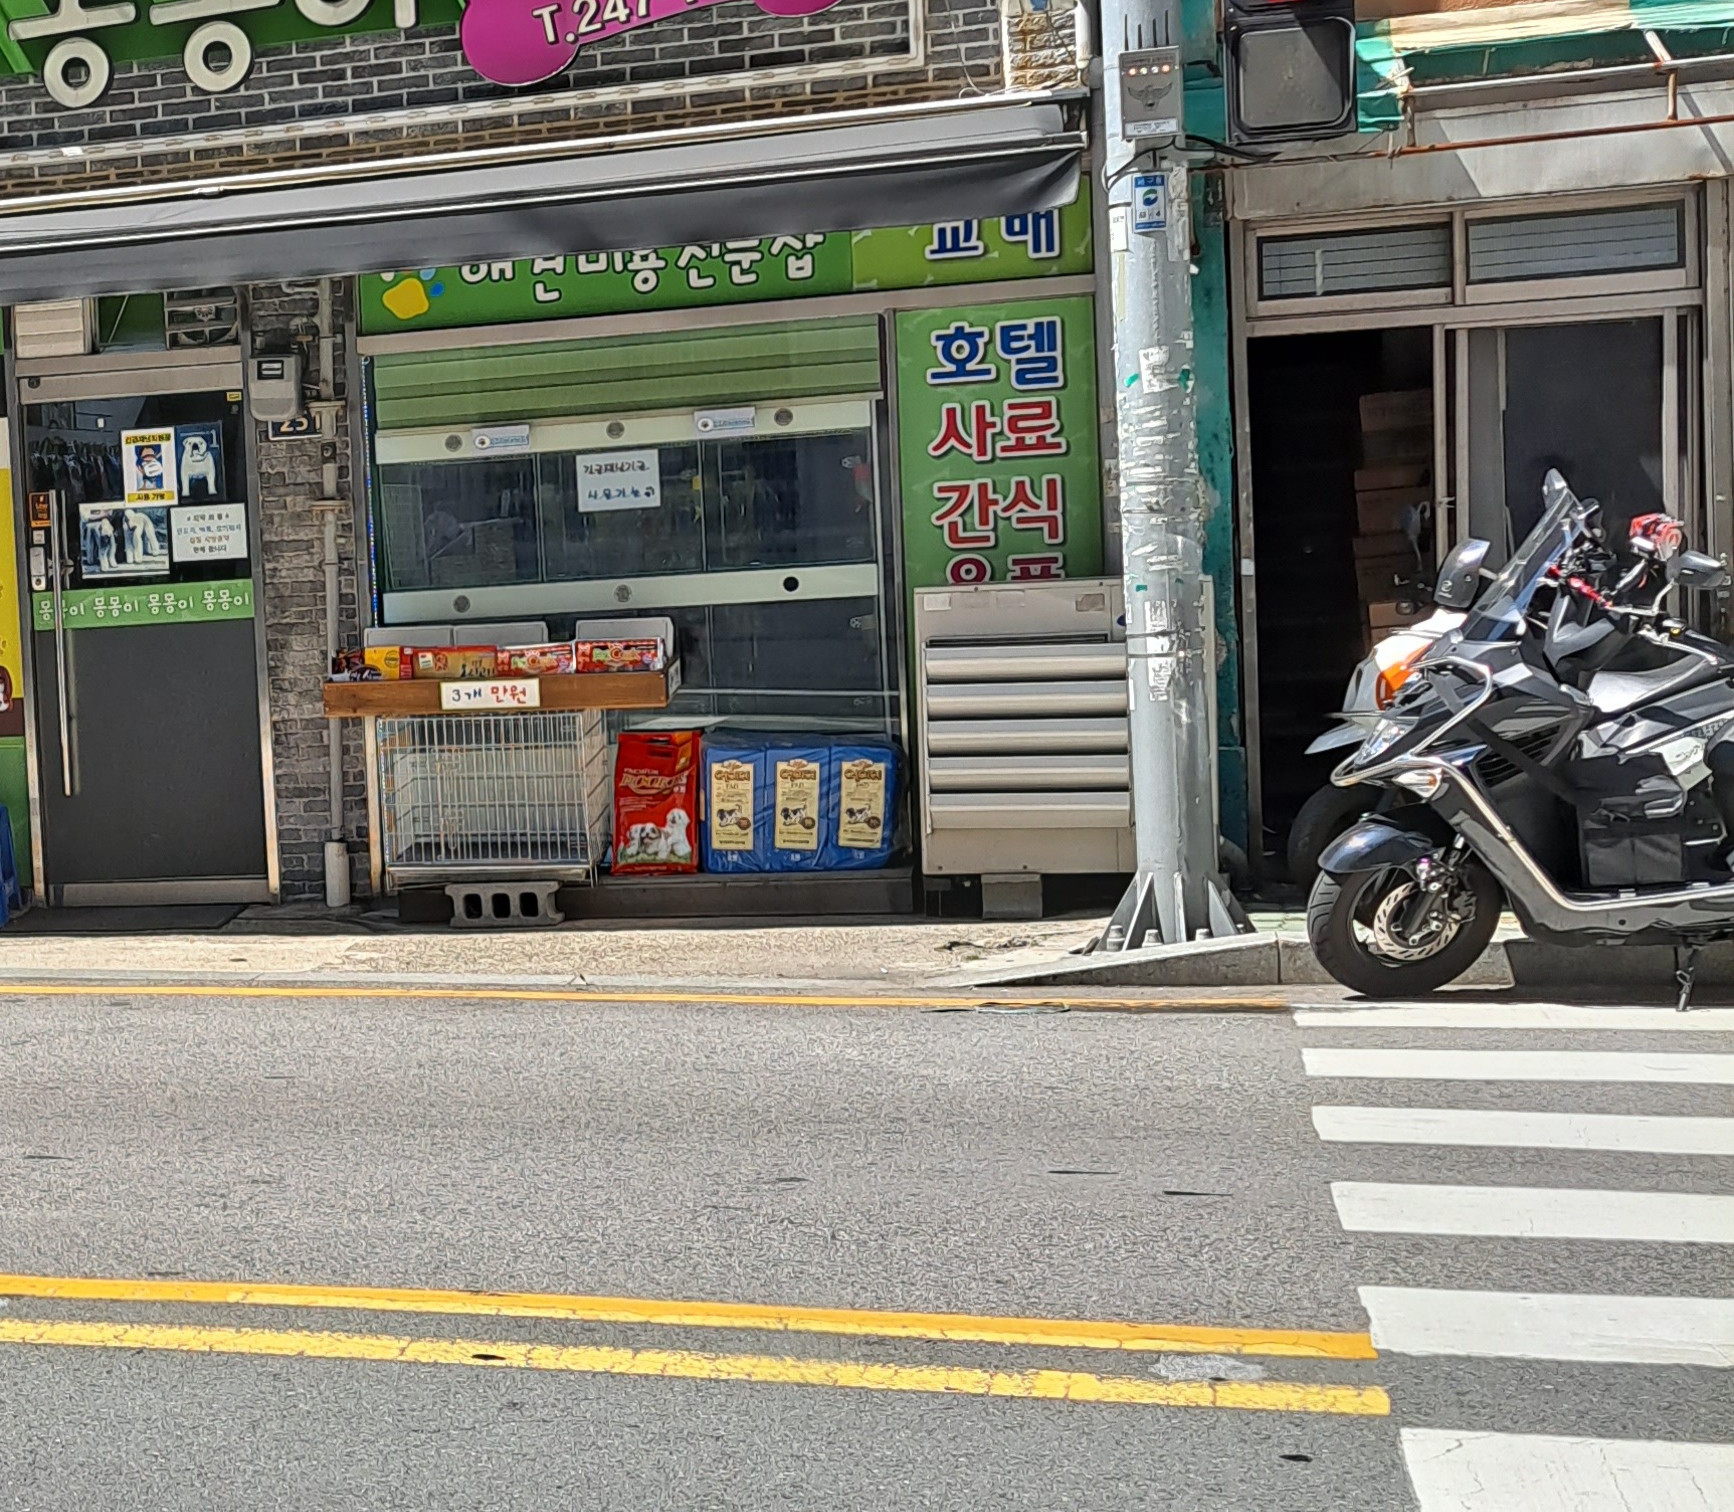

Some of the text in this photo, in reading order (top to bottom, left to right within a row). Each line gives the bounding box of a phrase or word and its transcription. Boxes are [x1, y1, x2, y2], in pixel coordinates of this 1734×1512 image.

[926, 315, 1065, 390] 호텔
[927, 395, 1067, 462] 사료
[931, 473, 1064, 549] 간식
[39, 600, 85, 621] 몽이
[147, 592, 194, 615] 몽몽이
[202, 589, 250, 612] 몽몽이
[451, 685, 527, 704] 3개 만원
